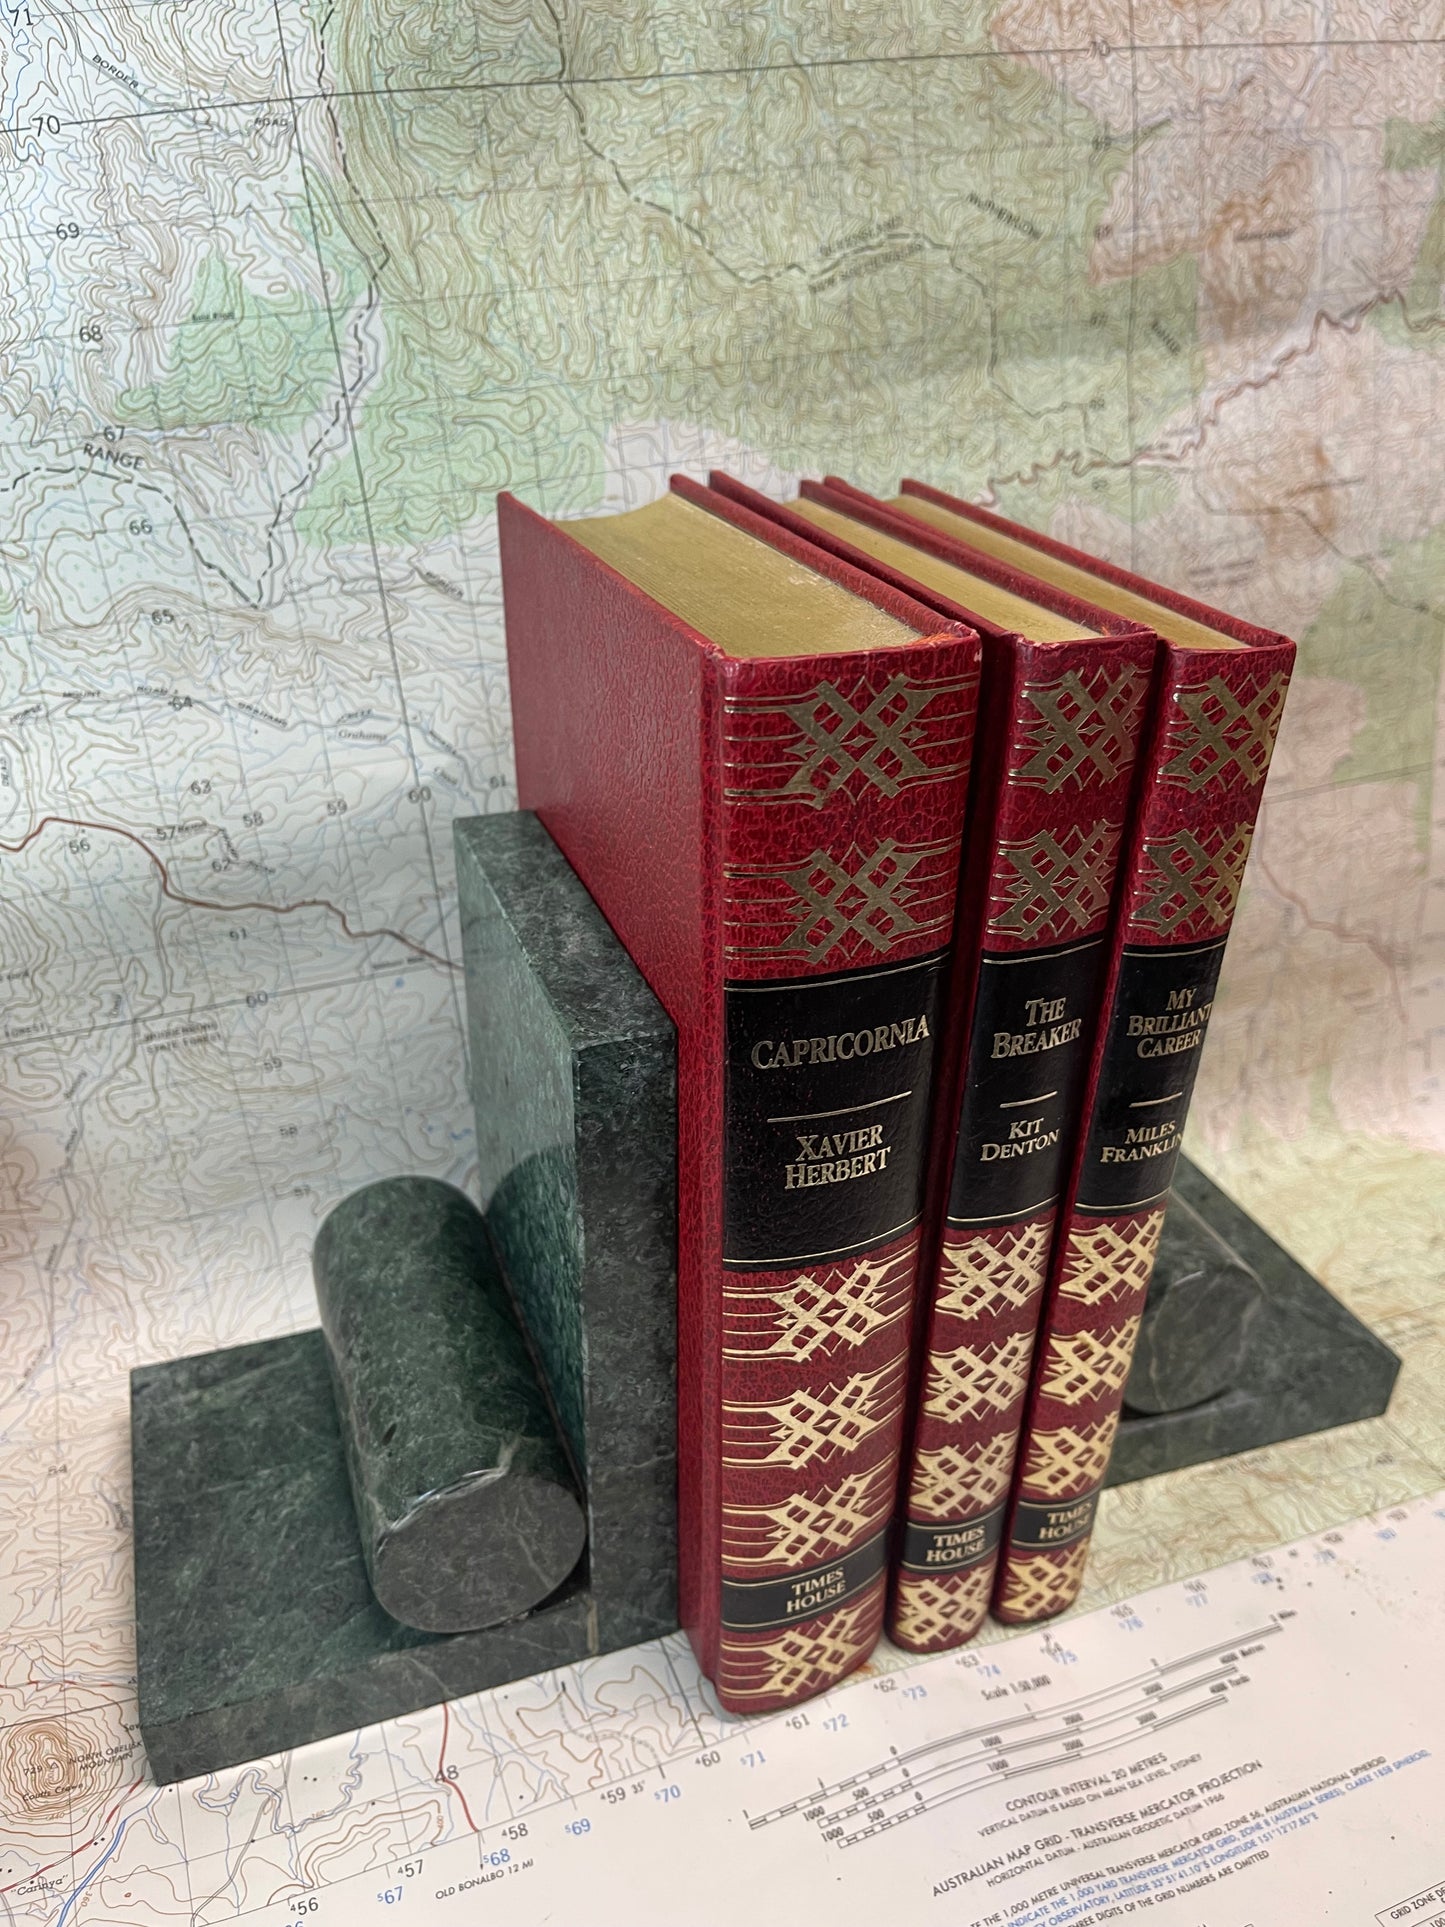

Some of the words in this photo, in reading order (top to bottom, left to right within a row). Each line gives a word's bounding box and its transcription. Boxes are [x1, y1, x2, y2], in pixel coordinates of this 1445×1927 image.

[9, 9, 34, 26] 71
[92, 54, 139, 89] BORDER
[32, 115, 61, 137] 70
[56, 222, 80, 239] 69
[79, 325, 104, 343] 68
[103, 425, 125, 442] 67
[83, 443, 144, 470] RANGE
[129, 519, 153, 535] 66
[151, 609, 175, 625] 65
[190, 778, 212, 795] 63
[408, 786, 432, 804] 60
[242, 811, 264, 828] 58
[327, 800, 348, 816] 59
[156, 826, 175, 840] 57
[69, 839, 91, 854] 56
[246, 990, 268, 1008] 60
[1165, 988, 1197, 1012] MY
[1024, 997, 1066, 1028] THE
[1126, 1003, 1214, 1037] BRILLIANT
[751, 1014, 931, 1070] CAPRICORNIA
[990, 1017, 1082, 1060] BREAKER
[1136, 1029, 1202, 1059] CAREER
[1008, 1117, 1045, 1142] KIT
[1124, 1120, 1176, 1145] MILES
[797, 1124, 884, 1163] XAVIER
[980, 1129, 1059, 1162] DENTON
[1099, 1132, 1183, 1163] FRANKLIN
[784, 1147, 891, 1190] HERBERT
[1047, 1501, 1093, 1526] TIMES
[933, 1525, 985, 1548] TIMES
[1038, 1515, 1091, 1539] HOUSE
[926, 1540, 985, 1563] HOUSE
[791, 1567, 844, 1596] TIMES
[786, 1581, 846, 1614] HOUSE
[68, 1751, 103, 1765] NORTH
[105, 1741, 143, 1756] OBELISK
[79, 1752, 133, 1771] MOUNTAIN
[23, 1766, 43, 1776] 729
[435, 1765, 459, 1783] 48
[1005, 1788, 1059, 1812] CONTOUR
[1061, 1774, 1111, 1795] INTERVAL
[1111, 1768, 1127, 1780] 20
[1128, 1752, 1168, 1774] METRES
[54, 1783, 84, 1795] Crown
[802, 1805, 825, 1821] 1000
[852, 1787, 869, 1801] 500
[821, 1826, 844, 1842] 1000
[867, 1808, 885, 1823] 500
[932, 1856, 1006, 1897] AUSTRALIAN
[1006, 1844, 1032, 1863] MAP
[1034, 1833, 1063, 1851] GRID
[1070, 1811, 1138, 1840] TRANSVERSE
[1139, 1788, 1198, 1819] MERCATOR
[1197, 1759, 1263, 1794] PROJECTION
[977, 1816, 1019, 1838] VERTICAL
[1019, 1807, 1049, 1822] DATUM
[982, 1912, 1002, 1926] THE
[1003, 1900, 1029, 1918] 1,000
[1030, 1886, 1059, 1906] METRE
[1059, 1870, 1106, 1892] UNIVERSAL
[1106, 1853, 1157, 1876] TRANSVERSE
[1157, 1836, 1201, 1860] MERCATOR
[1224, 1815, 1250, 1832] ZONE
[1264, 1788, 1310, 1814] AUSTRALIAN
[1309, 1771, 1351, 1794] NATIONAL
[1351, 1755, 1387, 1777] SPHEROID
[986, 1856, 1045, 1888] HORIZONTAL
[1045, 1846, 1075, 1862] DATUM
[1083, 1829, 1132, 1851] AUSTRALIAN
[1131, 1814, 1174, 1836] GEODETIC
[1173, 1803, 1204, 1820] DATUM
[435, 1886, 456, 1900] OLD
[459, 1869, 504, 1891] BONALBO
[508, 1863, 519, 1874] 12
[522, 1859, 534, 1870] MI
[1008, 1905, 1050, 1927] INDICATE
[1050, 1896, 1069, 1910] THE
[1070, 1886, 1095, 1902] 1,000
[1094, 1879, 1118, 1892] YARD
[1118, 1862, 1170, 1885] TRANSVERSE
[1171, 1843, 1216, 1869] MERCATOR
[1240, 1821, 1264, 1838] ZONE
[1113, 1881, 1152, 1900] LATITUDE
[1211, 1838, 1258, 1866] LONGITUDE
[1095, 1906, 1124, 1922] DIGITS
[1124, 1902, 1136, 1912] OF
[1136, 1896, 1154, 1909] THE
[1155, 1890, 1176, 1903] GRID
[1176, 1873, 1216, 1894] NUMBERS
[1217, 1866, 1234, 1880] ARE
[1233, 1849, 1270, 1870] OMITTED
[81, 1892, 92, 1907] 360
[1390, 1905, 1411, 1919] GRID
[1411, 1893, 1437, 1910] ZONE
